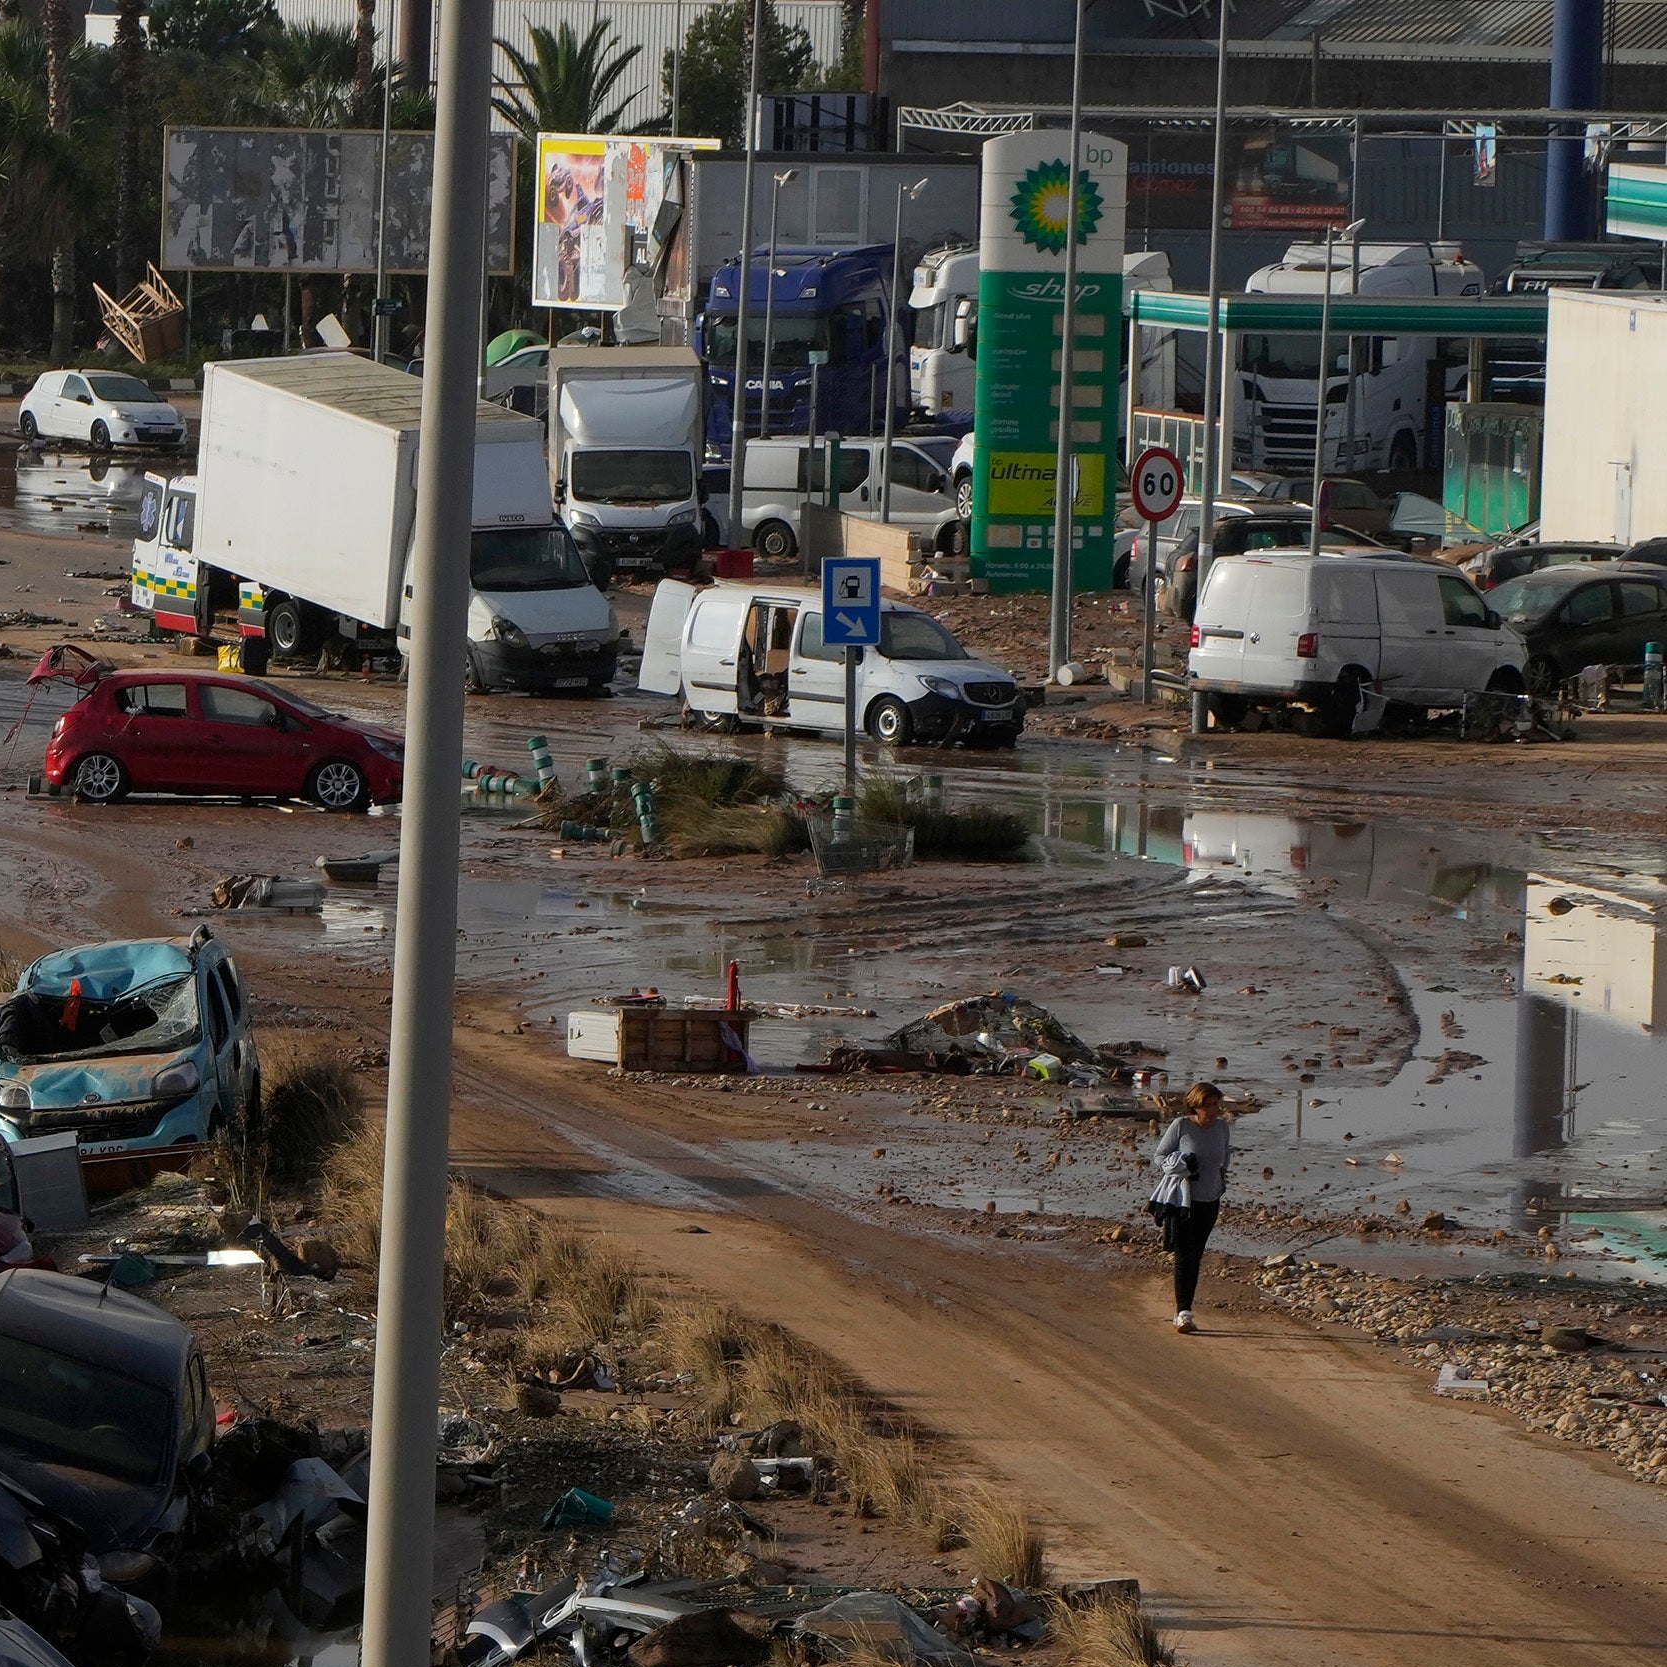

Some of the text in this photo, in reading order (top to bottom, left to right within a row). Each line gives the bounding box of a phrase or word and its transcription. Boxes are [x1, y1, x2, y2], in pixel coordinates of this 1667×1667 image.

[1086, 144, 1113, 168] bp
[1128, 159, 1215, 175] amiones
[990, 462, 1057, 481] ultima
[1143, 472, 1174, 497] 60
